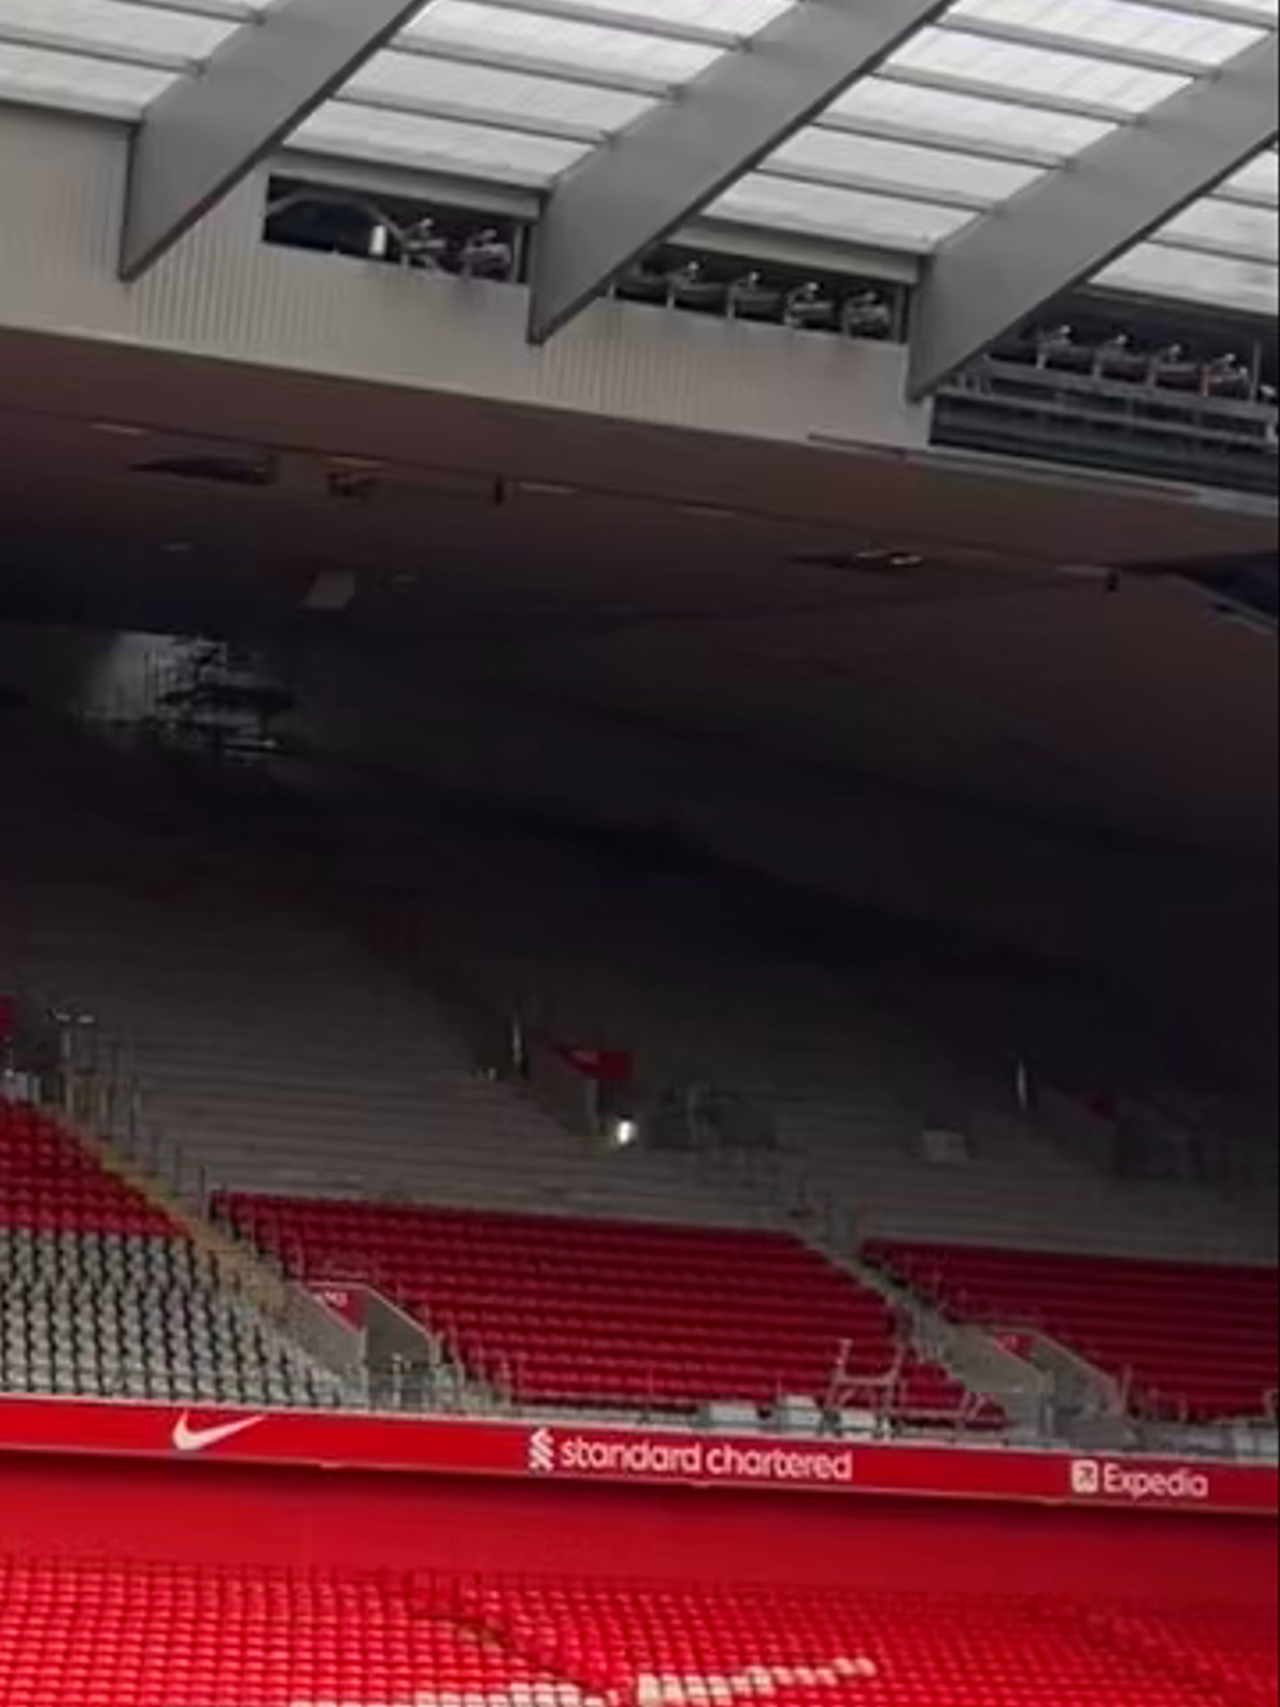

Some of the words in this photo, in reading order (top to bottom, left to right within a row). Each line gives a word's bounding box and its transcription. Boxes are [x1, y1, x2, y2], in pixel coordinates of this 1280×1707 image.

[559, 1436, 703, 1473] standard
[705, 1444, 854, 1481] chartered
[1103, 1461, 1209, 1501] Expedia
